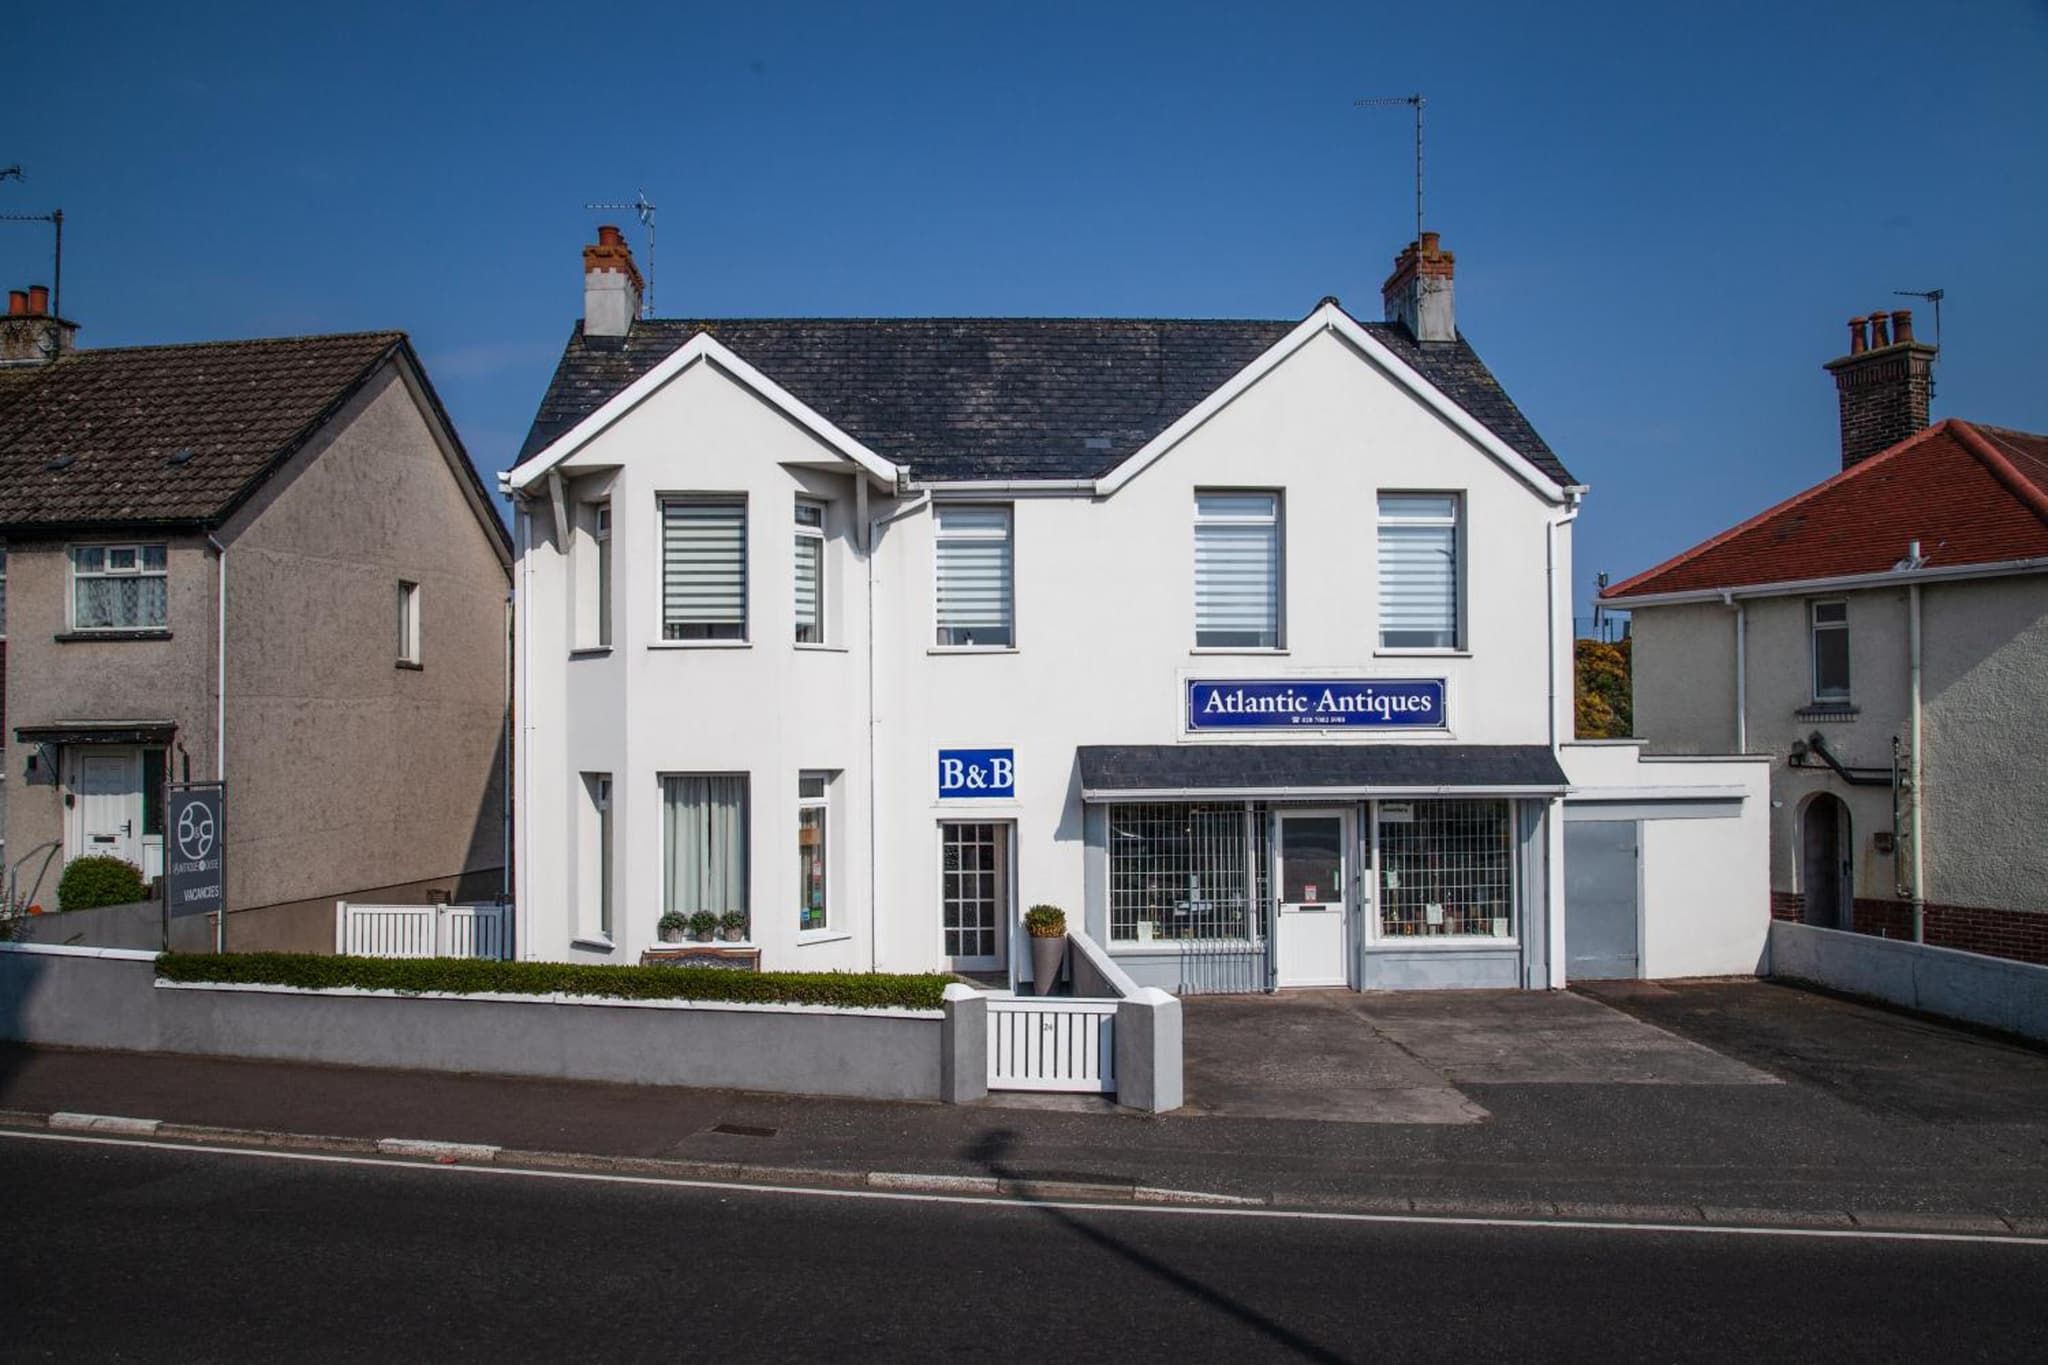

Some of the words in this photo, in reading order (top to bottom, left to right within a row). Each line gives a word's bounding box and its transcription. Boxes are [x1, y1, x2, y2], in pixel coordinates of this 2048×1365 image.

[1202, 688, 1308, 713] Atlantic
[1316, 688, 1432, 721] Antiques
[940, 758, 1014, 789] B&B
[183, 885, 219, 902] VACANCIES
